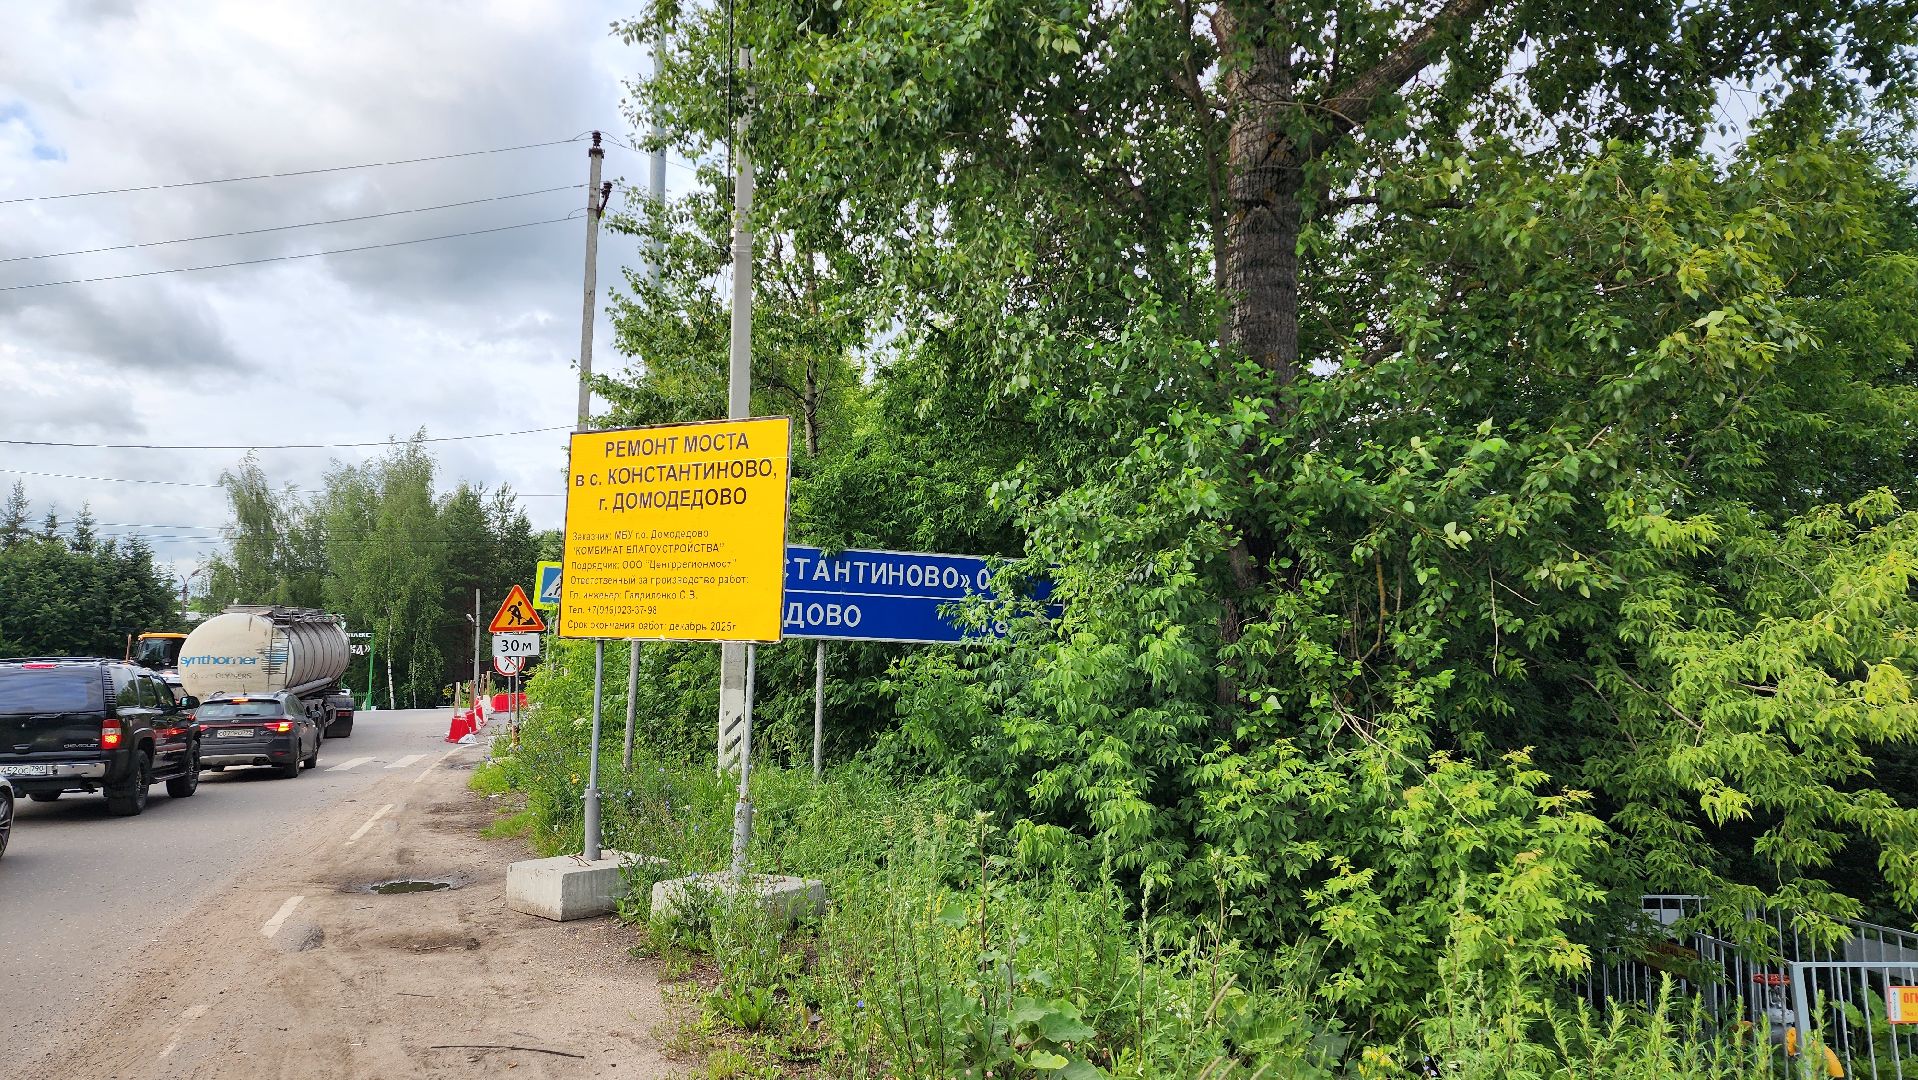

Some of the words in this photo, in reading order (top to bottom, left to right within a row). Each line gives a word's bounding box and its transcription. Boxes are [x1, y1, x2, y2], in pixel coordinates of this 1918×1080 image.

[605, 436, 679, 459] РЕМОНТ
[683, 432, 749, 454] МОСТА
[589, 474, 602, 487] с.
[608, 458, 777, 486] КОНСТАНТИНОВО,
[599, 498, 608, 511] г.
[612, 486, 747, 513] ДОМОДЕДОВО
[572, 531, 612, 541] Заказчик:
[614, 530, 634, 540] МБУ
[650, 529, 709, 540] Домодедово
[571, 561, 620, 572] Подрядчик:
[622, 560, 643, 570] ООО
[570, 575, 636, 585] Ответственный
[638, 577, 648, 585] за
[650, 576, 716, 587] производство
[718, 574, 749, 587] работ:
[568, 605, 585, 614] Тел.
[783, 602, 862, 628] ДОВО
[567, 619, 588, 631] Срок
[590, 621, 635, 630] окончания
[668, 621, 707, 633] декабрь
[180, 654, 260, 667] synthomer
